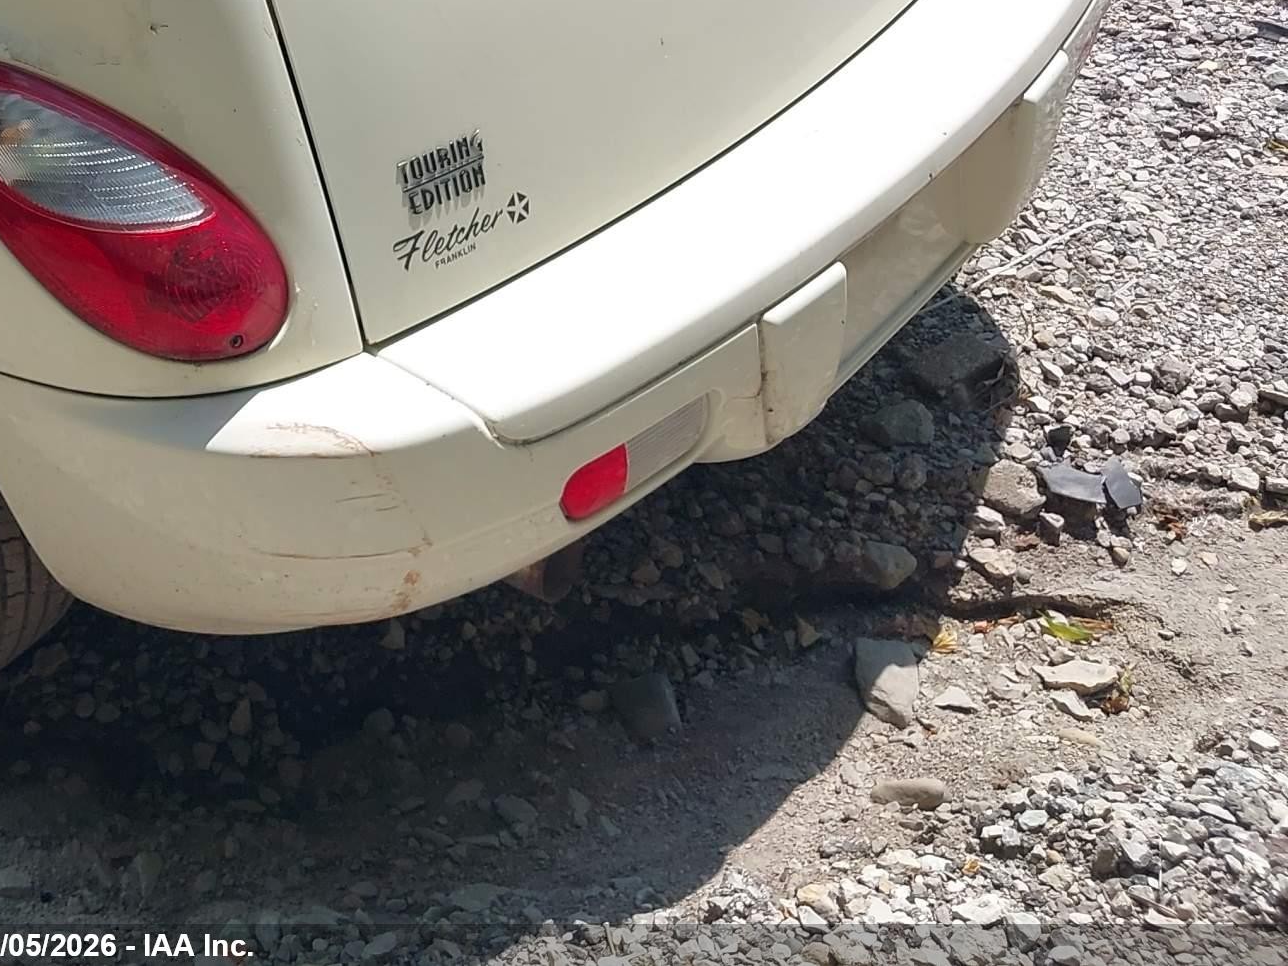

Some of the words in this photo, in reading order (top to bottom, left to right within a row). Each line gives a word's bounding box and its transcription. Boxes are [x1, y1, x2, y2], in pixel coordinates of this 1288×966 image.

[396, 128, 484, 184] TOURING
[408, 163, 486, 216] EDITION
[392, 207, 503, 272] Fletcher
[434, 242, 477, 270] FRANKLIN
